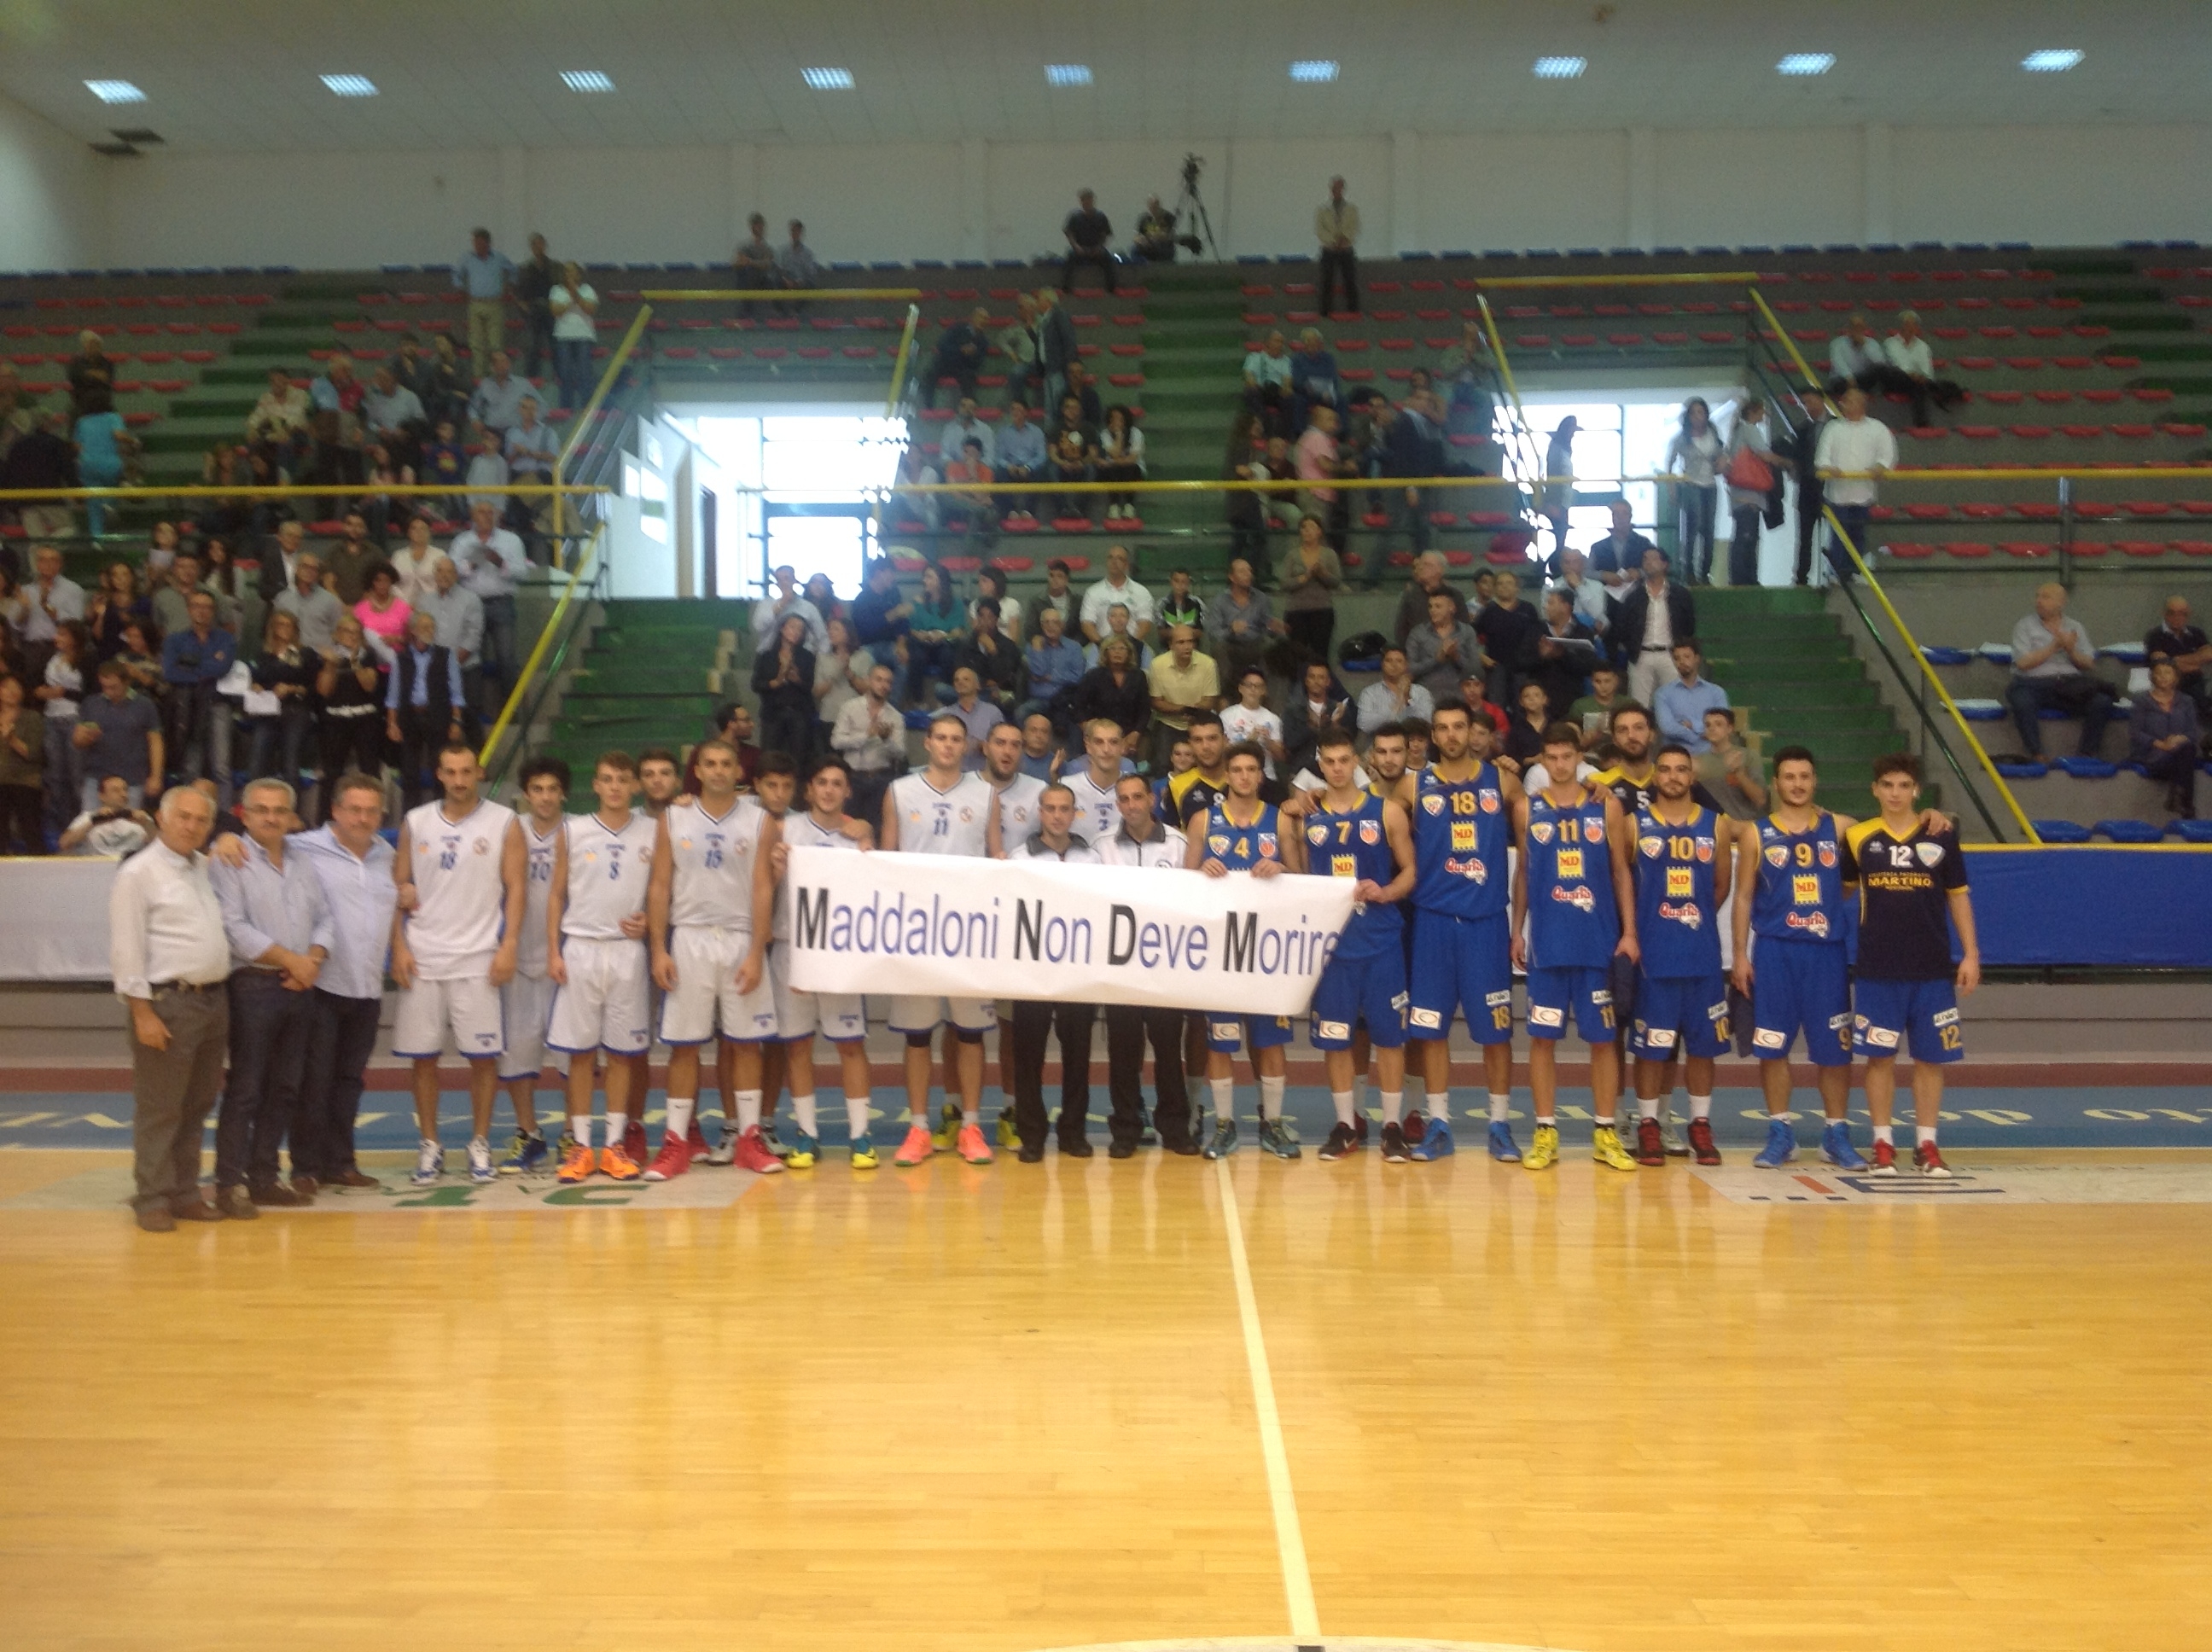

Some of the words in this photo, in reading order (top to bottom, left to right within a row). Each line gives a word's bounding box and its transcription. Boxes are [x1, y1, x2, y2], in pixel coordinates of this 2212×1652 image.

[1451, 791, 1476, 815] 18
[1636, 790, 1650, 809] 5
[1336, 821, 1353, 845] 7
[1453, 829, 1472, 838] MD
[1558, 818, 1579, 843] 11
[1234, 837, 1250, 858] 4
[1668, 835, 1694, 860] 10
[1796, 843, 1813, 868] 9
[1889, 845, 1913, 867] 12
[1560, 856, 1579, 866] MD
[1669, 875, 1689, 885] MD
[1796, 882, 1816, 892] MD
[1869, 876, 1933, 887] MARTINO
[796, 887, 999, 959] Maddaloni
[1014, 899, 1091, 964] Non
[1108, 904, 1208, 971] Deve
[1223, 911, 1342, 974] Morire
[1492, 1006, 1511, 1030] 18
[1940, 1025, 1962, 1050] 12
[2083, 1108, 2212, 1125] to
